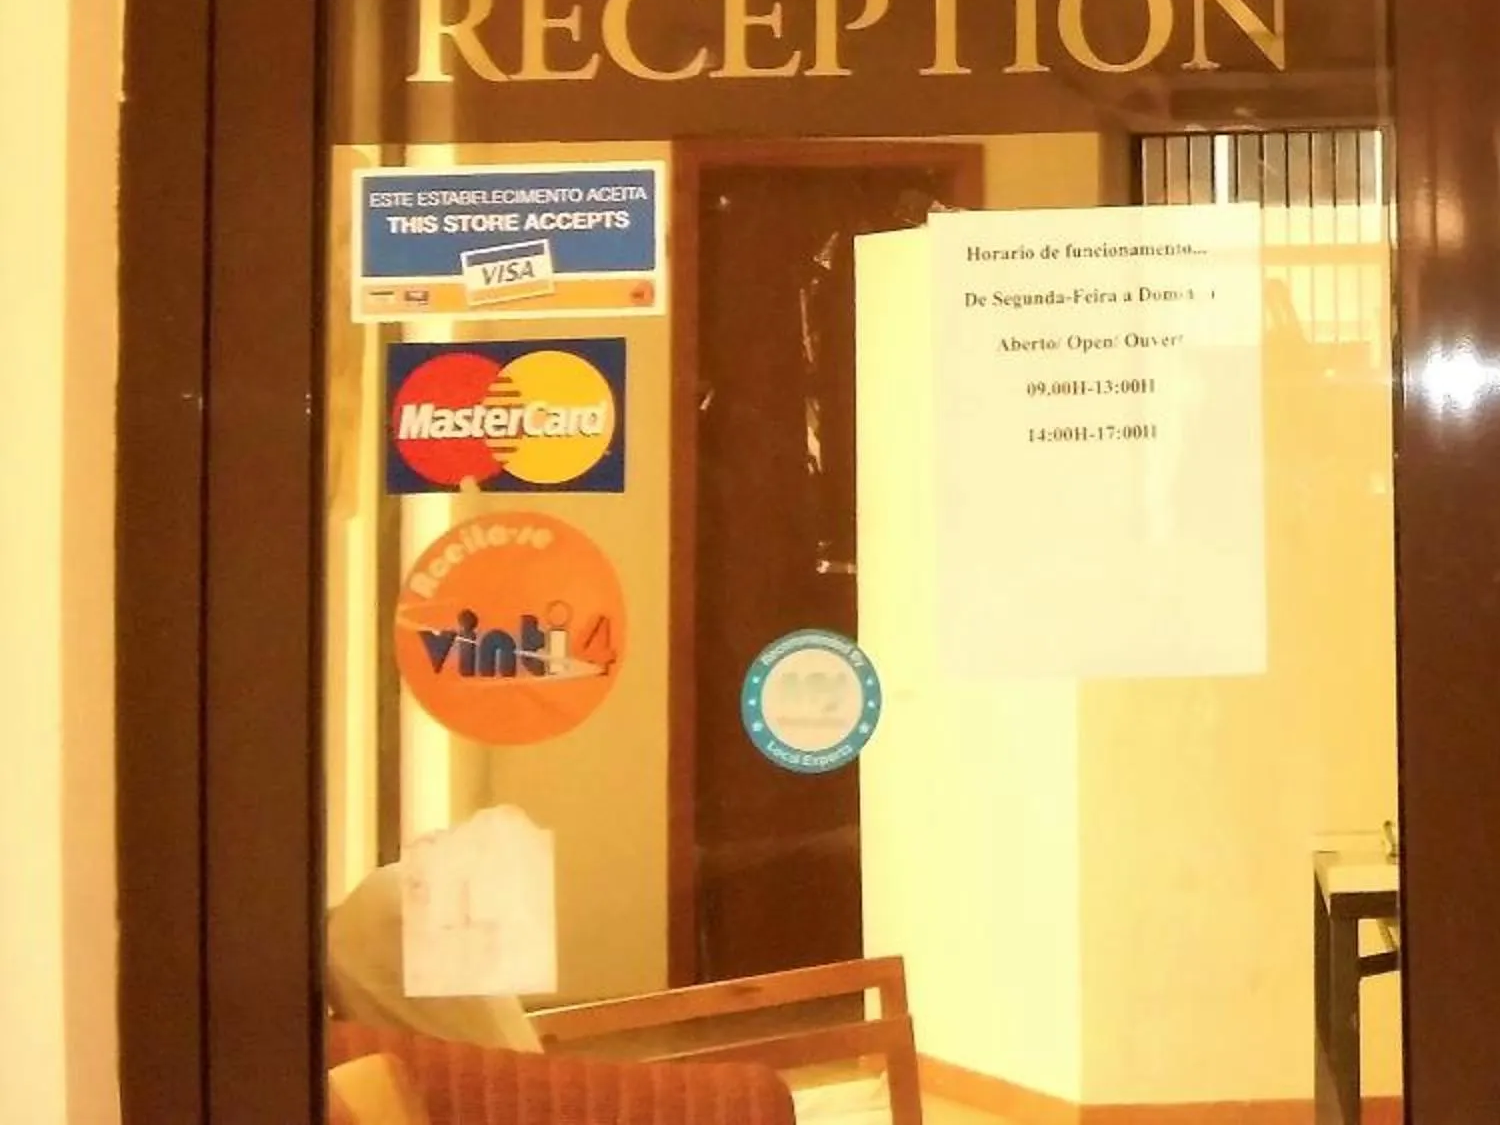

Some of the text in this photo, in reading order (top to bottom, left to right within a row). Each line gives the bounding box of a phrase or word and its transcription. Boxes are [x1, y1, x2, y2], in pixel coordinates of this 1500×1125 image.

[369, 185, 648, 208] ESTE ESTABELECIMENTO ACEITA
[386, 210, 631, 234] THIS STORE ACCEPTS
[966, 245, 1035, 262] Horario
[1040, 244, 1060, 260] de
[481, 259, 535, 286] VISA
[964, 291, 988, 308] De
[992, 288, 1117, 309] Segunda-Feira
[1123, 292, 1133, 302] a
[398, 400, 608, 440] MasterCard
